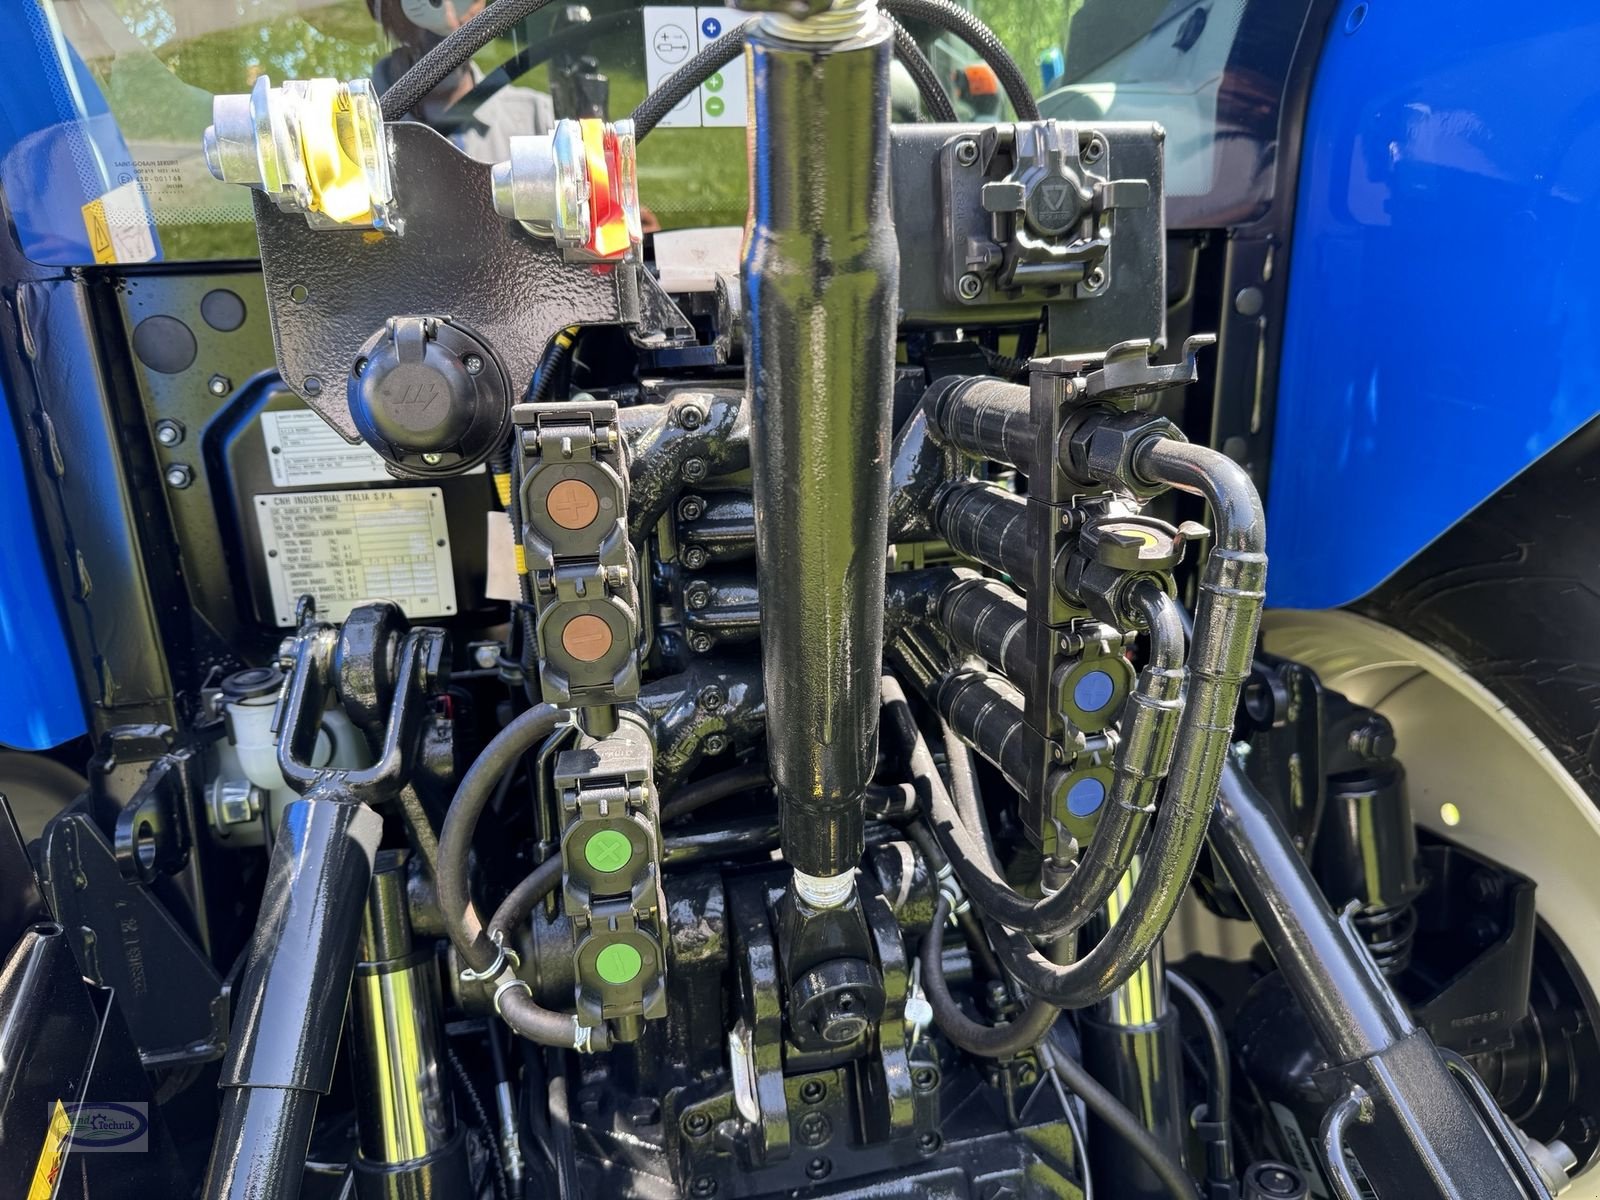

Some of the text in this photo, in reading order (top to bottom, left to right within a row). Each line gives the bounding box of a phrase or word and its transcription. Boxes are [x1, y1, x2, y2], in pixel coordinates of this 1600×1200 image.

[274, 496, 290, 506] CNH
[294, 494, 341, 505] INDUSTRIAL
[346, 493, 370, 503] ITALIA
